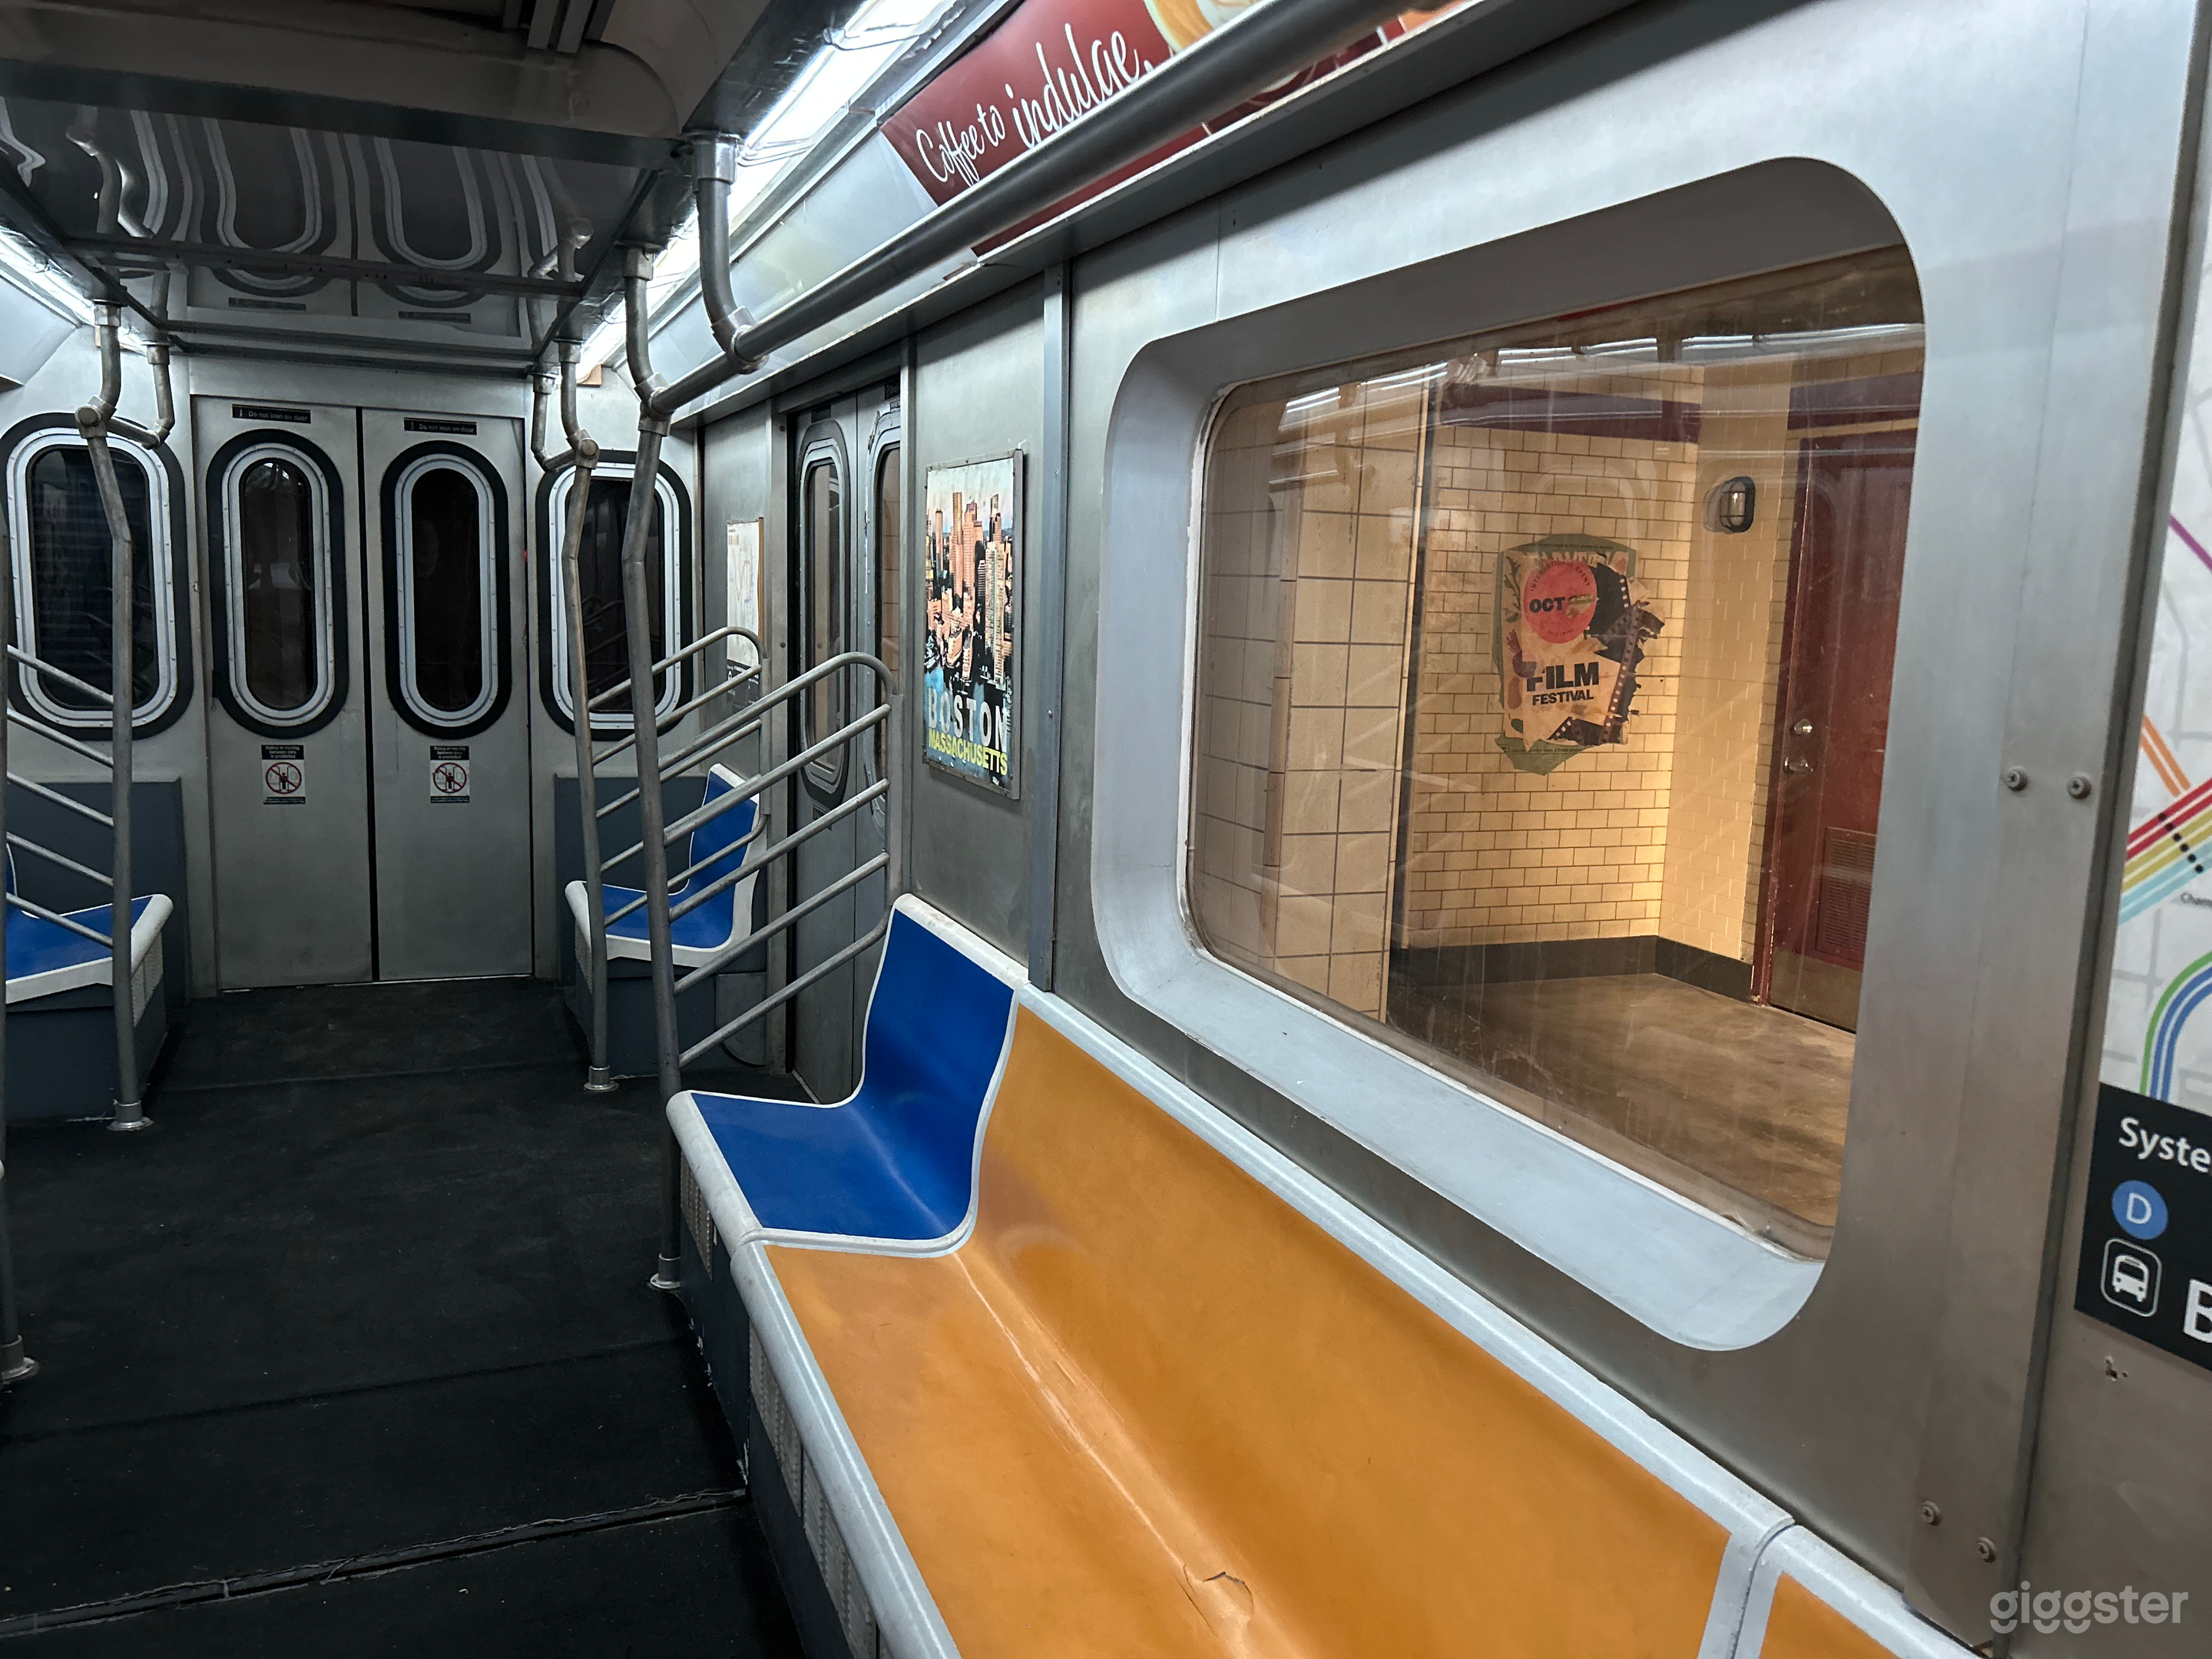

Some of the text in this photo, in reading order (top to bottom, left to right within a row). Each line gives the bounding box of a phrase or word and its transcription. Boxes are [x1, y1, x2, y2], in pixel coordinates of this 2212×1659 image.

[916, 121, 985, 187] Coffee
[976, 103, 1005, 147] to
[1575, 565, 1591, 586] EVENT
[1529, 597, 1565, 613] OCT
[1532, 689, 1594, 706] FESTIVAL
[928, 687, 1007, 753] BOSTON
[929, 728, 1008, 776] MASSACHUSETTS
[2126, 1192, 2152, 1225] D
